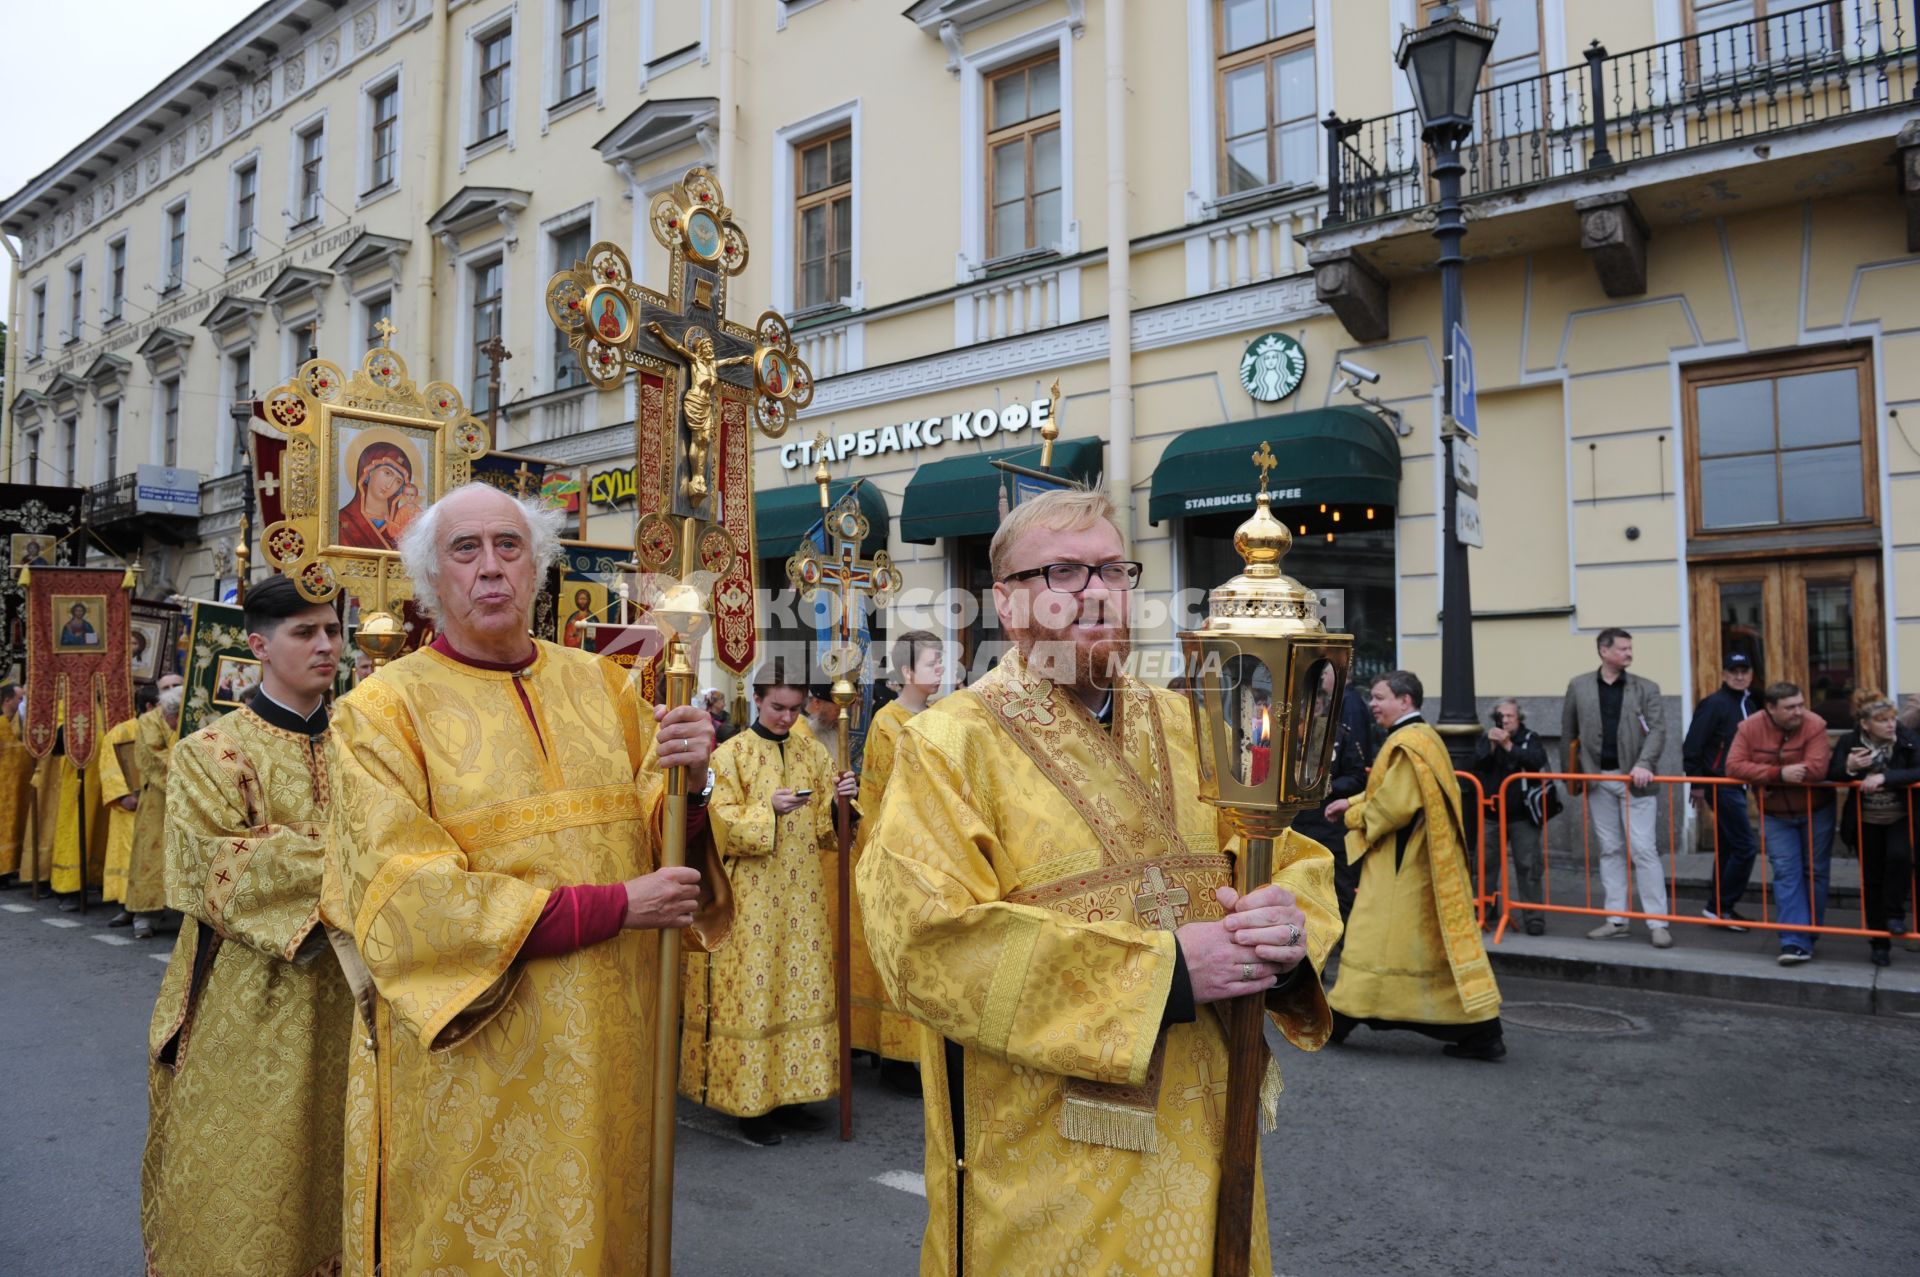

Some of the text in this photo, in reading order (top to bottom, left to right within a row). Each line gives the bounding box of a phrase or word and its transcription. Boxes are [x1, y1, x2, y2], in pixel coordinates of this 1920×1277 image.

[1459, 342, 1471, 417] P
[780, 399, 1051, 470] СТАРБАКС КОФЕ
[1185, 493, 1252, 510] STARBUCKS
